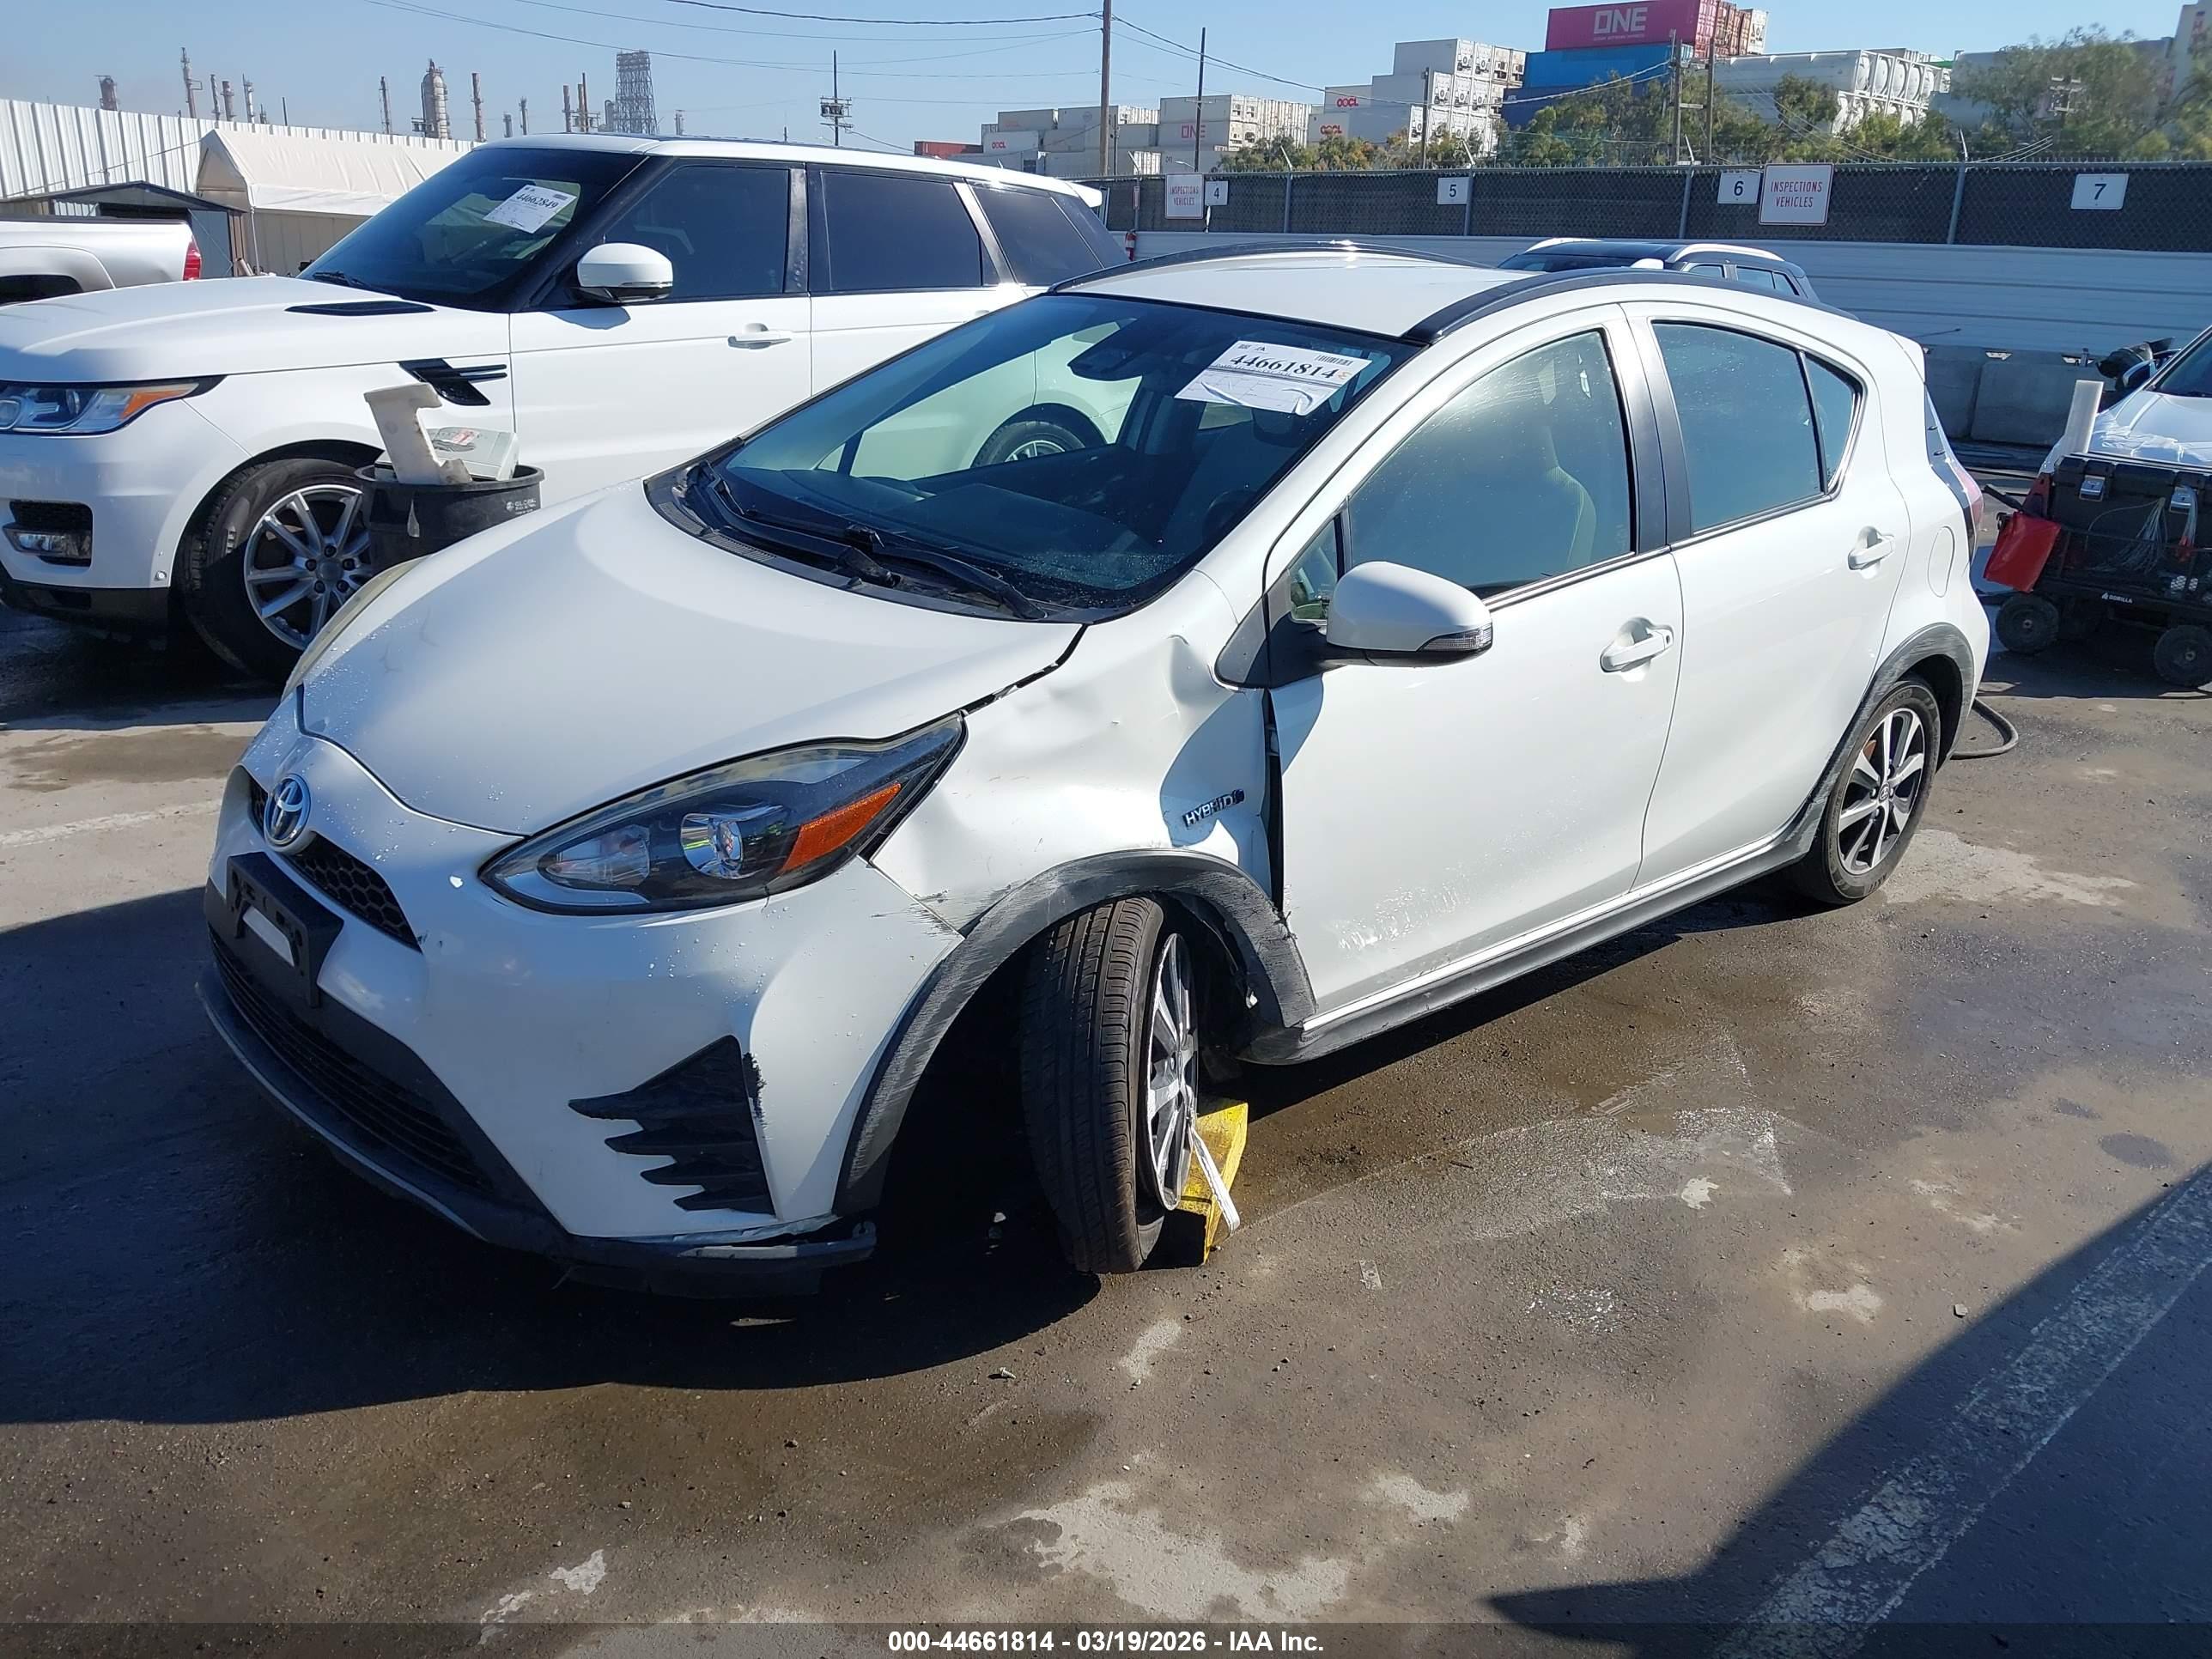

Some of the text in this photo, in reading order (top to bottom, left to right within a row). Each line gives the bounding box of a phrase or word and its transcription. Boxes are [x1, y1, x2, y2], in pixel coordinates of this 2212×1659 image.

[1594, 7, 1648, 33] ONE
[1337, 96, 1358, 107] OOCL
[1182, 125, 1206, 138] ONE
[1170, 185, 1199, 195] INSPECTIONS
[1213, 187, 1220, 199] 4
[1449, 184, 1457, 198] 5
[1734, 180, 1744, 197] 6
[1771, 181, 1823, 192] INSPECTIONS
[2094, 183, 2107, 200] 7
[516, 193, 559, 209] 44662849
[1173, 197, 1195, 207] VEHICLES
[1776, 196, 1814, 208] VEHICLES
[1230, 355, 1340, 379] 44661814
[1184, 794, 1235, 825] HYBRID
